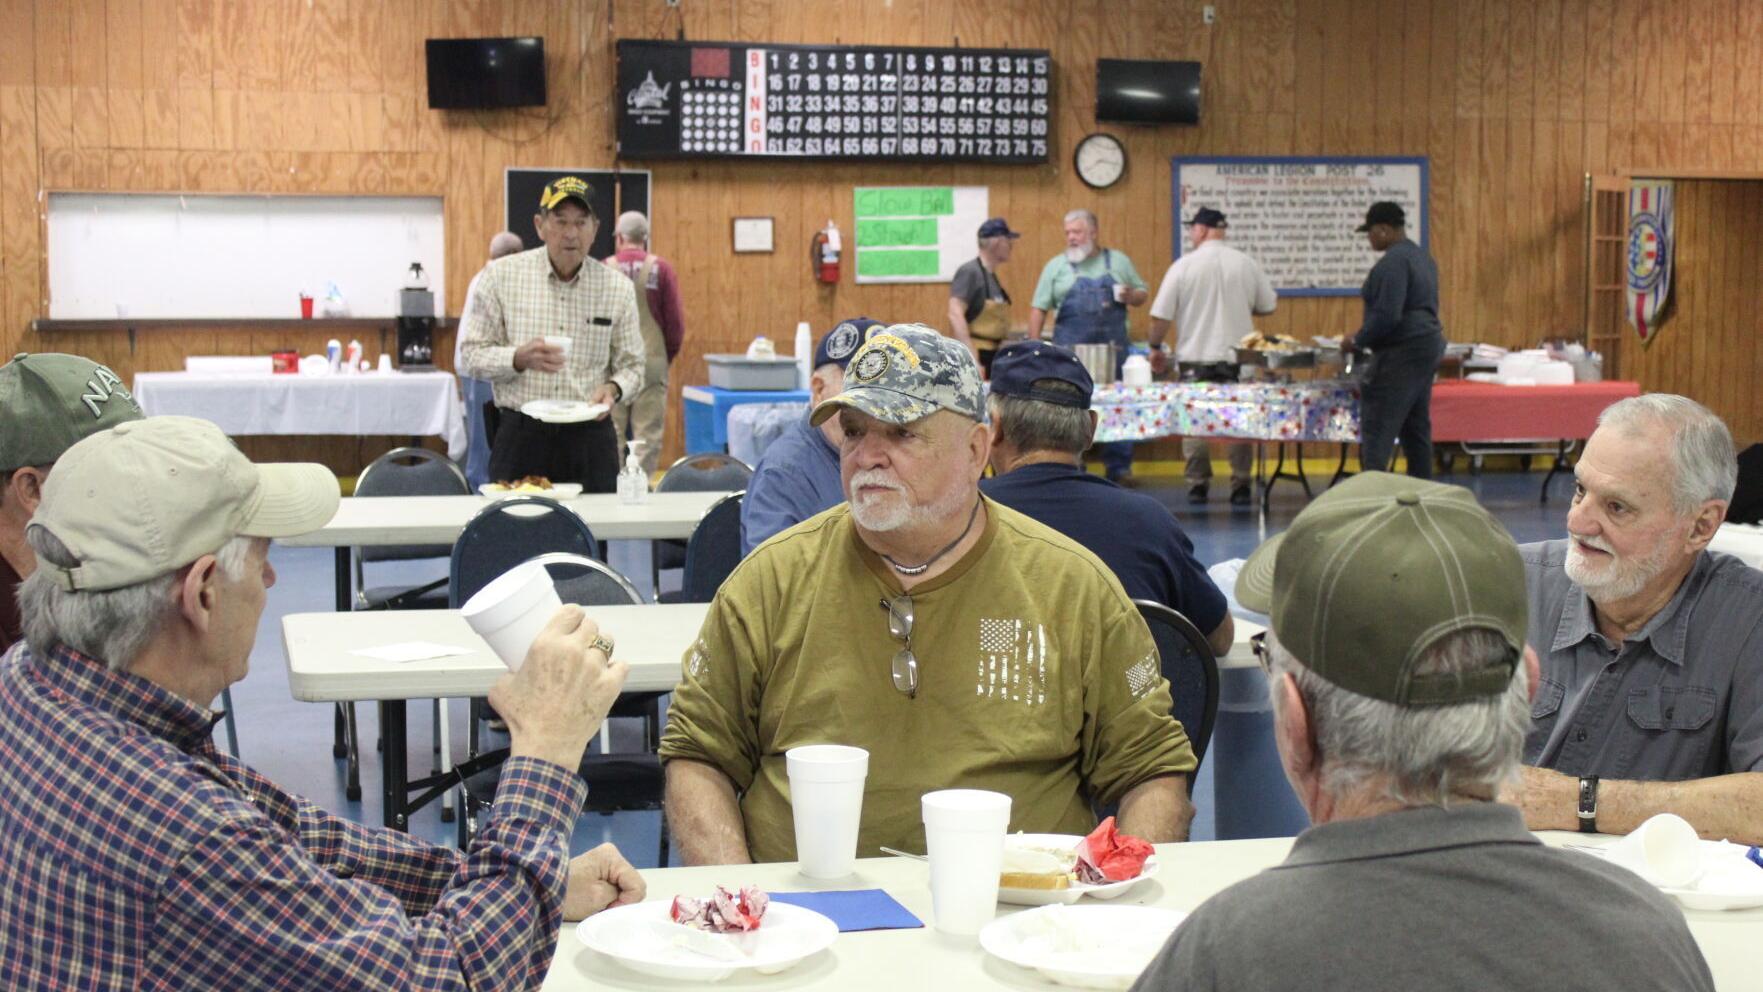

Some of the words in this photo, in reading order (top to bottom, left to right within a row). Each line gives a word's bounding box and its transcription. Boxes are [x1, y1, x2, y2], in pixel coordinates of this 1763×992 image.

[771, 53, 779, 69] 1
[789, 53, 799, 70] 2
[809, 53, 818, 70] 3
[827, 54, 836, 69] 4
[846, 53, 856, 70] 5
[865, 53, 874, 70] 6
[884, 54, 893, 69] 7
[907, 54, 916, 71] 8
[925, 55, 935, 71] 9
[942, 55, 956, 72] 10
[961, 57, 973, 71] 11
[979, 57, 992, 72] 12
[998, 57, 1011, 73] 13
[1016, 59, 1028, 73] 14
[1034, 58, 1046, 73] 15
[768, 74, 783, 91] 16
[787, 74, 801, 90] 17
[806, 74, 821, 91] 18
[826, 74, 840, 91] 19
[842, 74, 860, 91] 20
[862, 74, 877, 91] 21
[881, 74, 897, 92] 22
[903, 75, 919, 91] 23
[922, 75, 937, 91] 24
[940, 76, 956, 92] 25
[959, 76, 974, 92] 26
[977, 77, 992, 92] 27
[996, 77, 1011, 93] 28
[1014, 78, 1029, 93] 29
[1032, 78, 1047, 93] 30
[768, 95, 783, 112] 31
[786, 95, 803, 112] 32
[805, 95, 822, 112] 33
[824, 95, 841, 112] 34
[843, 95, 860, 112] 35
[862, 95, 879, 112] 36
[881, 96, 897, 112] 37
[902, 96, 919, 112] 38
[922, 96, 937, 113] 39
[940, 97, 956, 113] 40
[959, 98, 974, 112] 41
[977, 98, 993, 113] 42
[996, 98, 1011, 114] 43
[1013, 99, 1028, 113] 44
[1032, 99, 1047, 114] 45
[767, 116, 783, 134] 46
[787, 116, 802, 132] 47
[805, 116, 822, 133] 48
[824, 116, 841, 133] 49
[844, 116, 860, 133] 50
[863, 116, 878, 133] 51
[881, 115, 897, 133] 52
[903, 117, 919, 133] 53
[921, 117, 937, 133] 54
[940, 118, 956, 134] 55
[958, 118, 974, 134] 56
[977, 118, 992, 134] 57
[995, 119, 1010, 134] 58
[1013, 119, 1028, 134] 59
[1031, 120, 1046, 135] 60
[767, 137, 783, 155] 61
[786, 137, 802, 155] 62
[804, 138, 822, 155] 63
[824, 138, 841, 155] 64
[843, 138, 860, 154] 65
[862, 138, 879, 154] 66
[881, 138, 897, 154] 67
[902, 138, 918, 154] 68
[921, 138, 937, 154] 69
[940, 138, 955, 154] 70
[960, 139, 973, 154] 71
[977, 139, 992, 155] 72
[996, 139, 1010, 155] 73
[1014, 140, 1027, 154] 74
[1032, 140, 1046, 155] 75
[1216, 165, 1269, 176] AMERICAN
[1274, 165, 1315, 176] LEGION
[1327, 165, 1355, 176] POST
